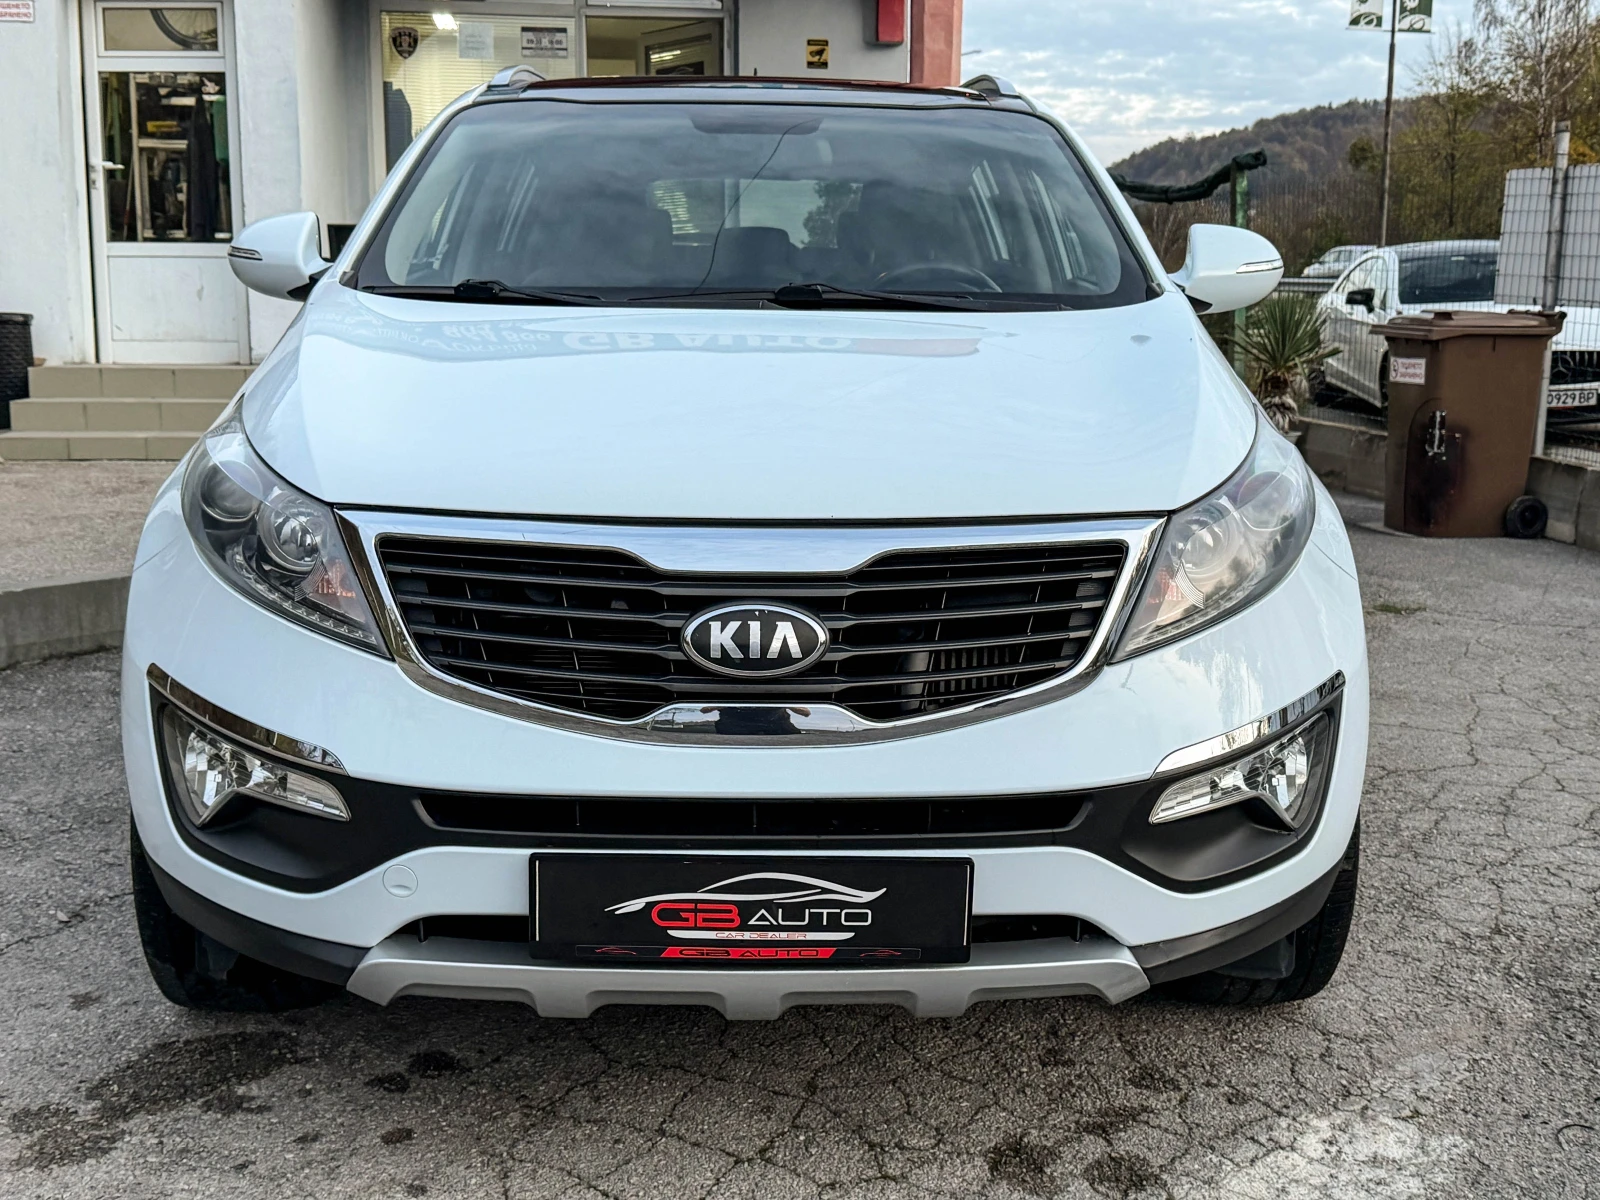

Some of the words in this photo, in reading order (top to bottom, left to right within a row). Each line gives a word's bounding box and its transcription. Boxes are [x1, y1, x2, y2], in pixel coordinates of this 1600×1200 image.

[709, 621, 803, 659] KIA
[651, 902, 741, 928] GB
[747, 908, 872, 926] AUTO
[715, 932, 746, 940] CAR
[748, 932, 807, 940] DEALER
[678, 948, 732, 958] GB
[738, 949, 819, 958] AUTO
